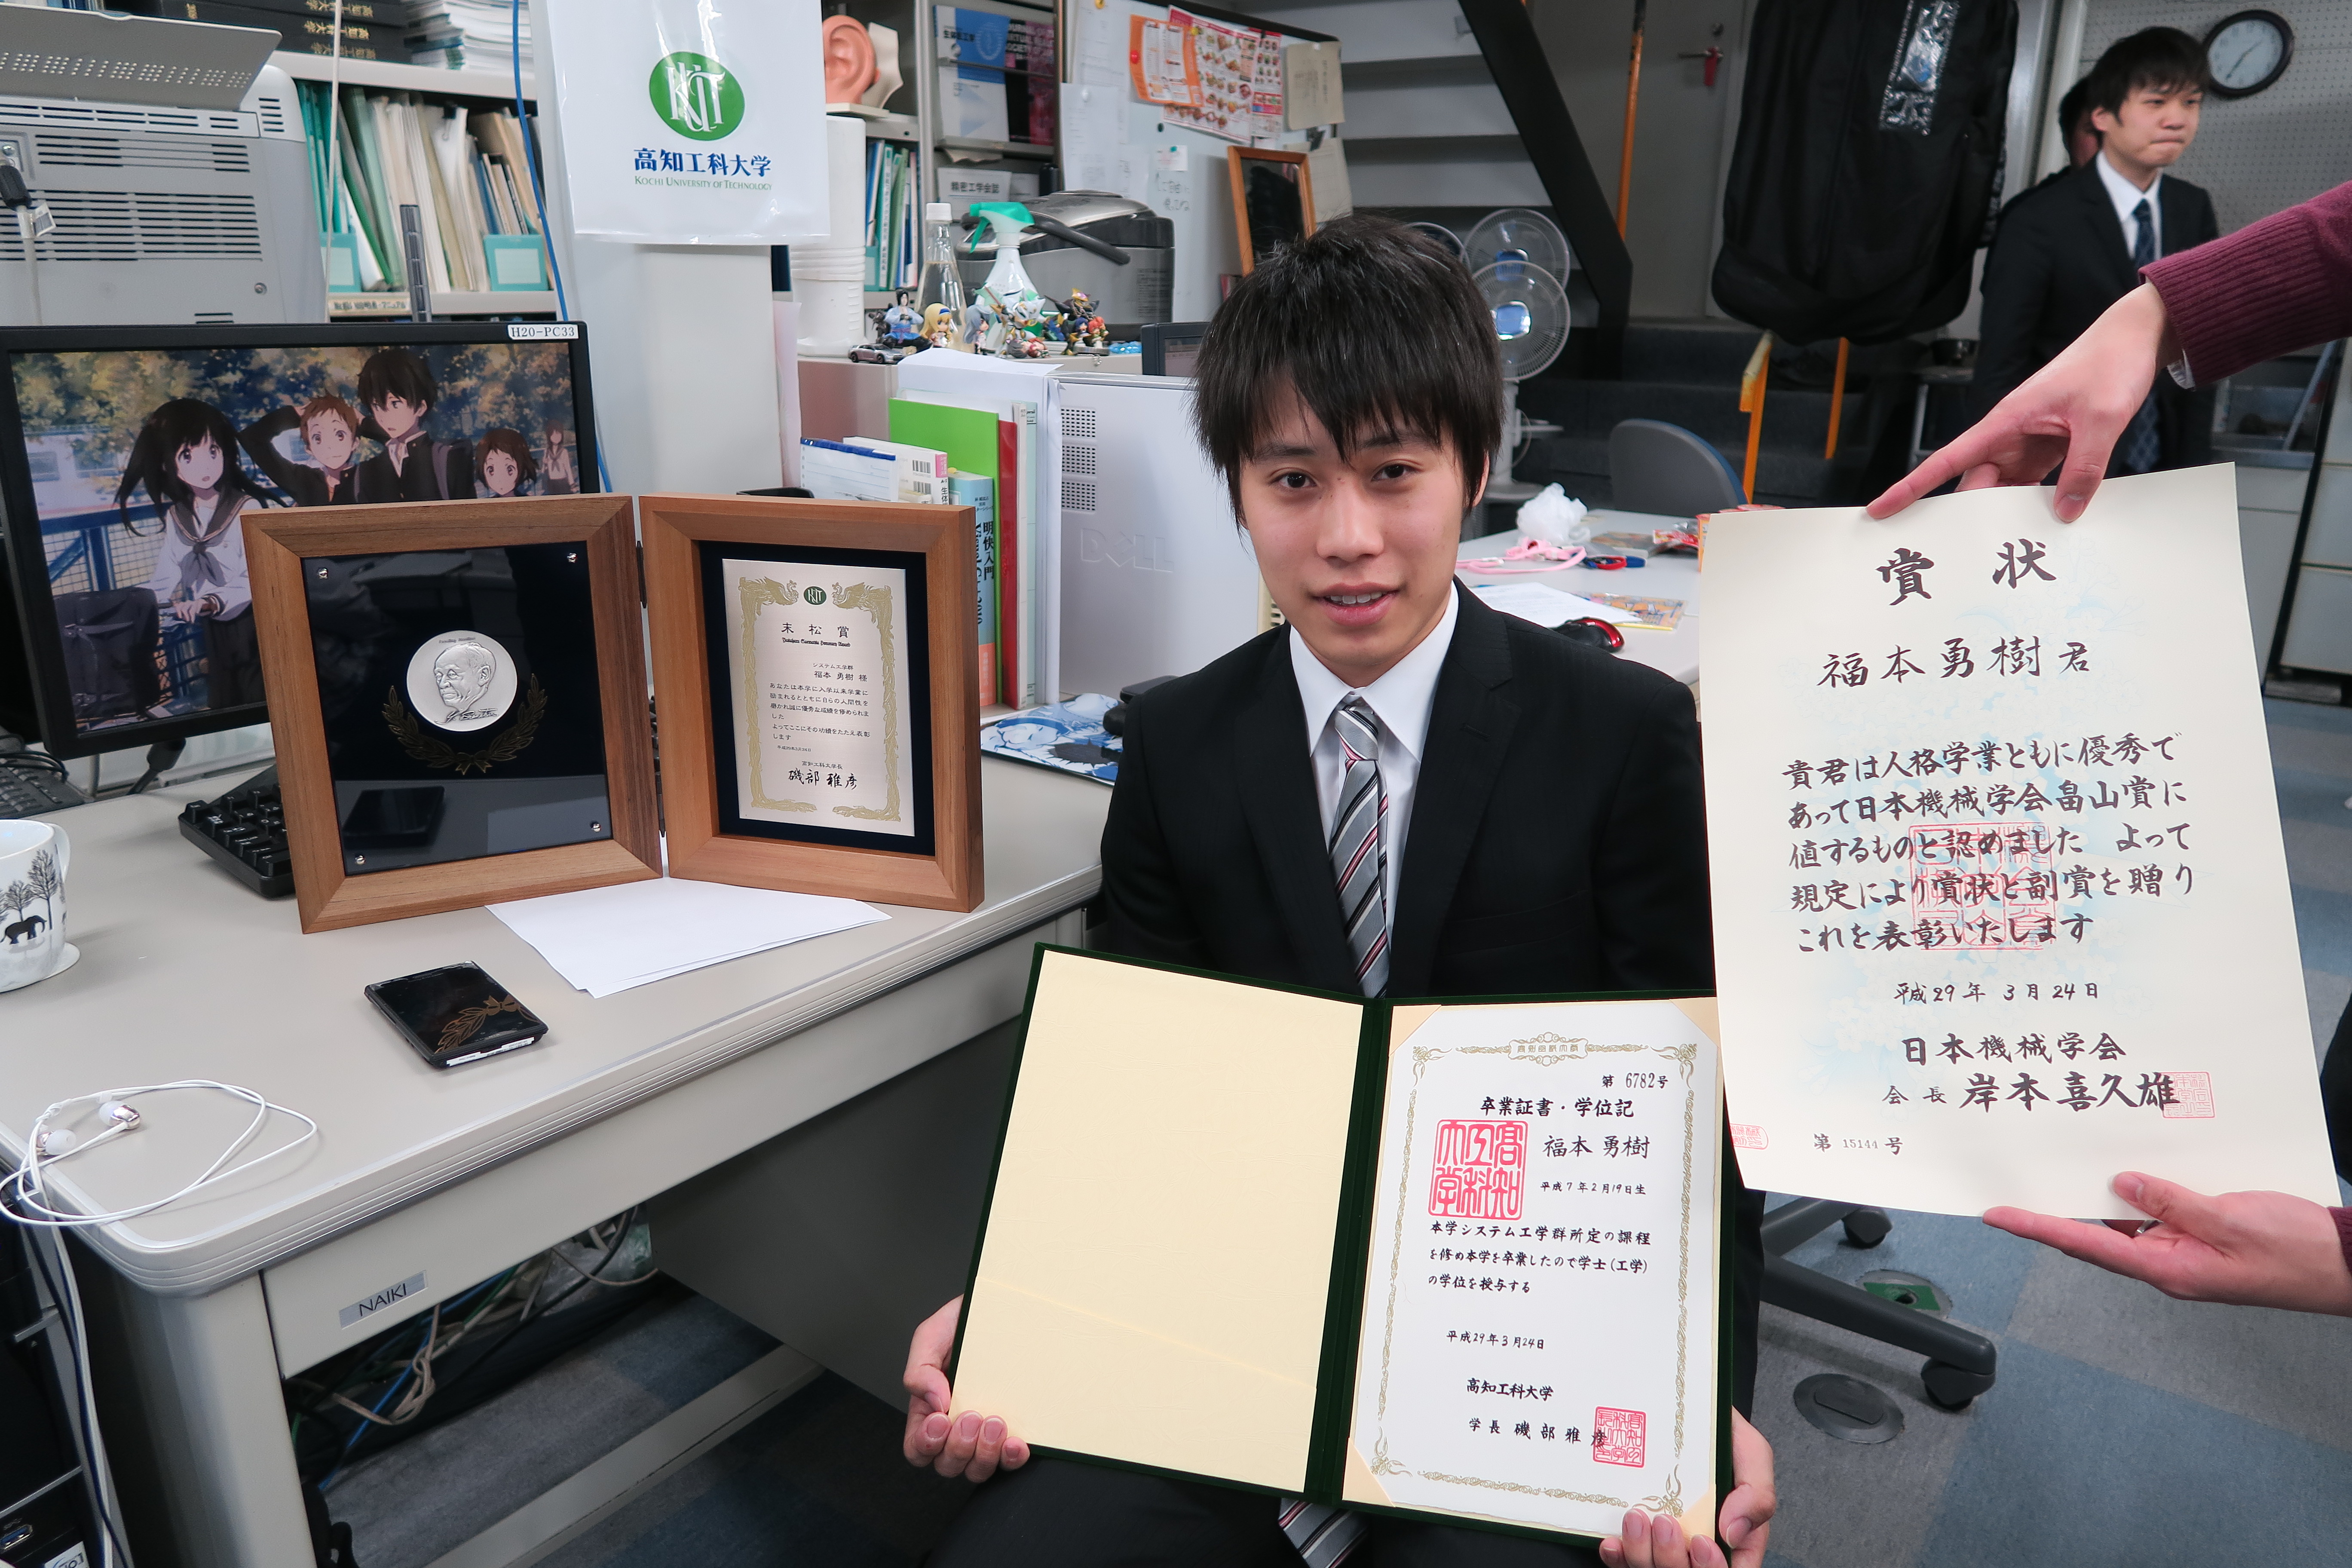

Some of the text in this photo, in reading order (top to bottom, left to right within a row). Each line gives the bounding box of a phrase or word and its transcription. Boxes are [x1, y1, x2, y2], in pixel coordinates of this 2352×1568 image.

[634, 147, 772, 177] 高知工科大学
[511, 325, 576, 338] H20-PC33
[983, 521, 994, 581] 明快入門
[1081, 527, 1174, 573] DELL
[1875, 539, 2057, 606] 賞状
[781, 622, 849, 638] 末松賞
[1816, 636, 2090, 688] 福本勇樹君
[814, 671, 867, 682] 福本 勇樹 様
[769, 692, 869, 706] 励まれるとともに自らの人間性を
[801, 760, 843, 770] 高知工科大学長
[1782, 731, 2182, 790] 貴君は人格学業ともに優秀で
[788, 767, 858, 790] 磯部 雅彦
[1787, 776, 2187, 829] あって日本機械学会畠山賞に
[1789, 821, 2191, 869] 値するものと認めました よって
[1791, 862, 2193, 912] 規定により賞状と副賞を贈り
[1799, 913, 2093, 952] これを表彰いたします
[1893, 981, 2100, 1004] 平成29年3月24日
[1902, 1032, 2126, 1066] 日本機械学会
[1625, 1072, 1668, 1090] 6782号
[1882, 1085, 1948, 1105] 会長
[1959, 1071, 2180, 1113] 岸本喜久雄
[1479, 1096, 1634, 1118] 卒業証書・学位記
[1543, 1134, 1651, 1159] 福本 勇樹
[1813, 1133, 1903, 1155] 第15144号
[1540, 1181, 1646, 1196] 平成7年2月19日生
[1430, 1219, 1651, 1245] 本学システム工学群所定の課程
[1428, 1274, 1530, 1293] の学位を授与する
[359, 1283, 407, 1317] NAIKI
[1446, 1329, 1545, 1350] 平成29年3月24日
[1467, 1377, 1554, 1402] 高知工科大学
[1469, 1417, 1608, 1450] 学長 磯部雅彦
